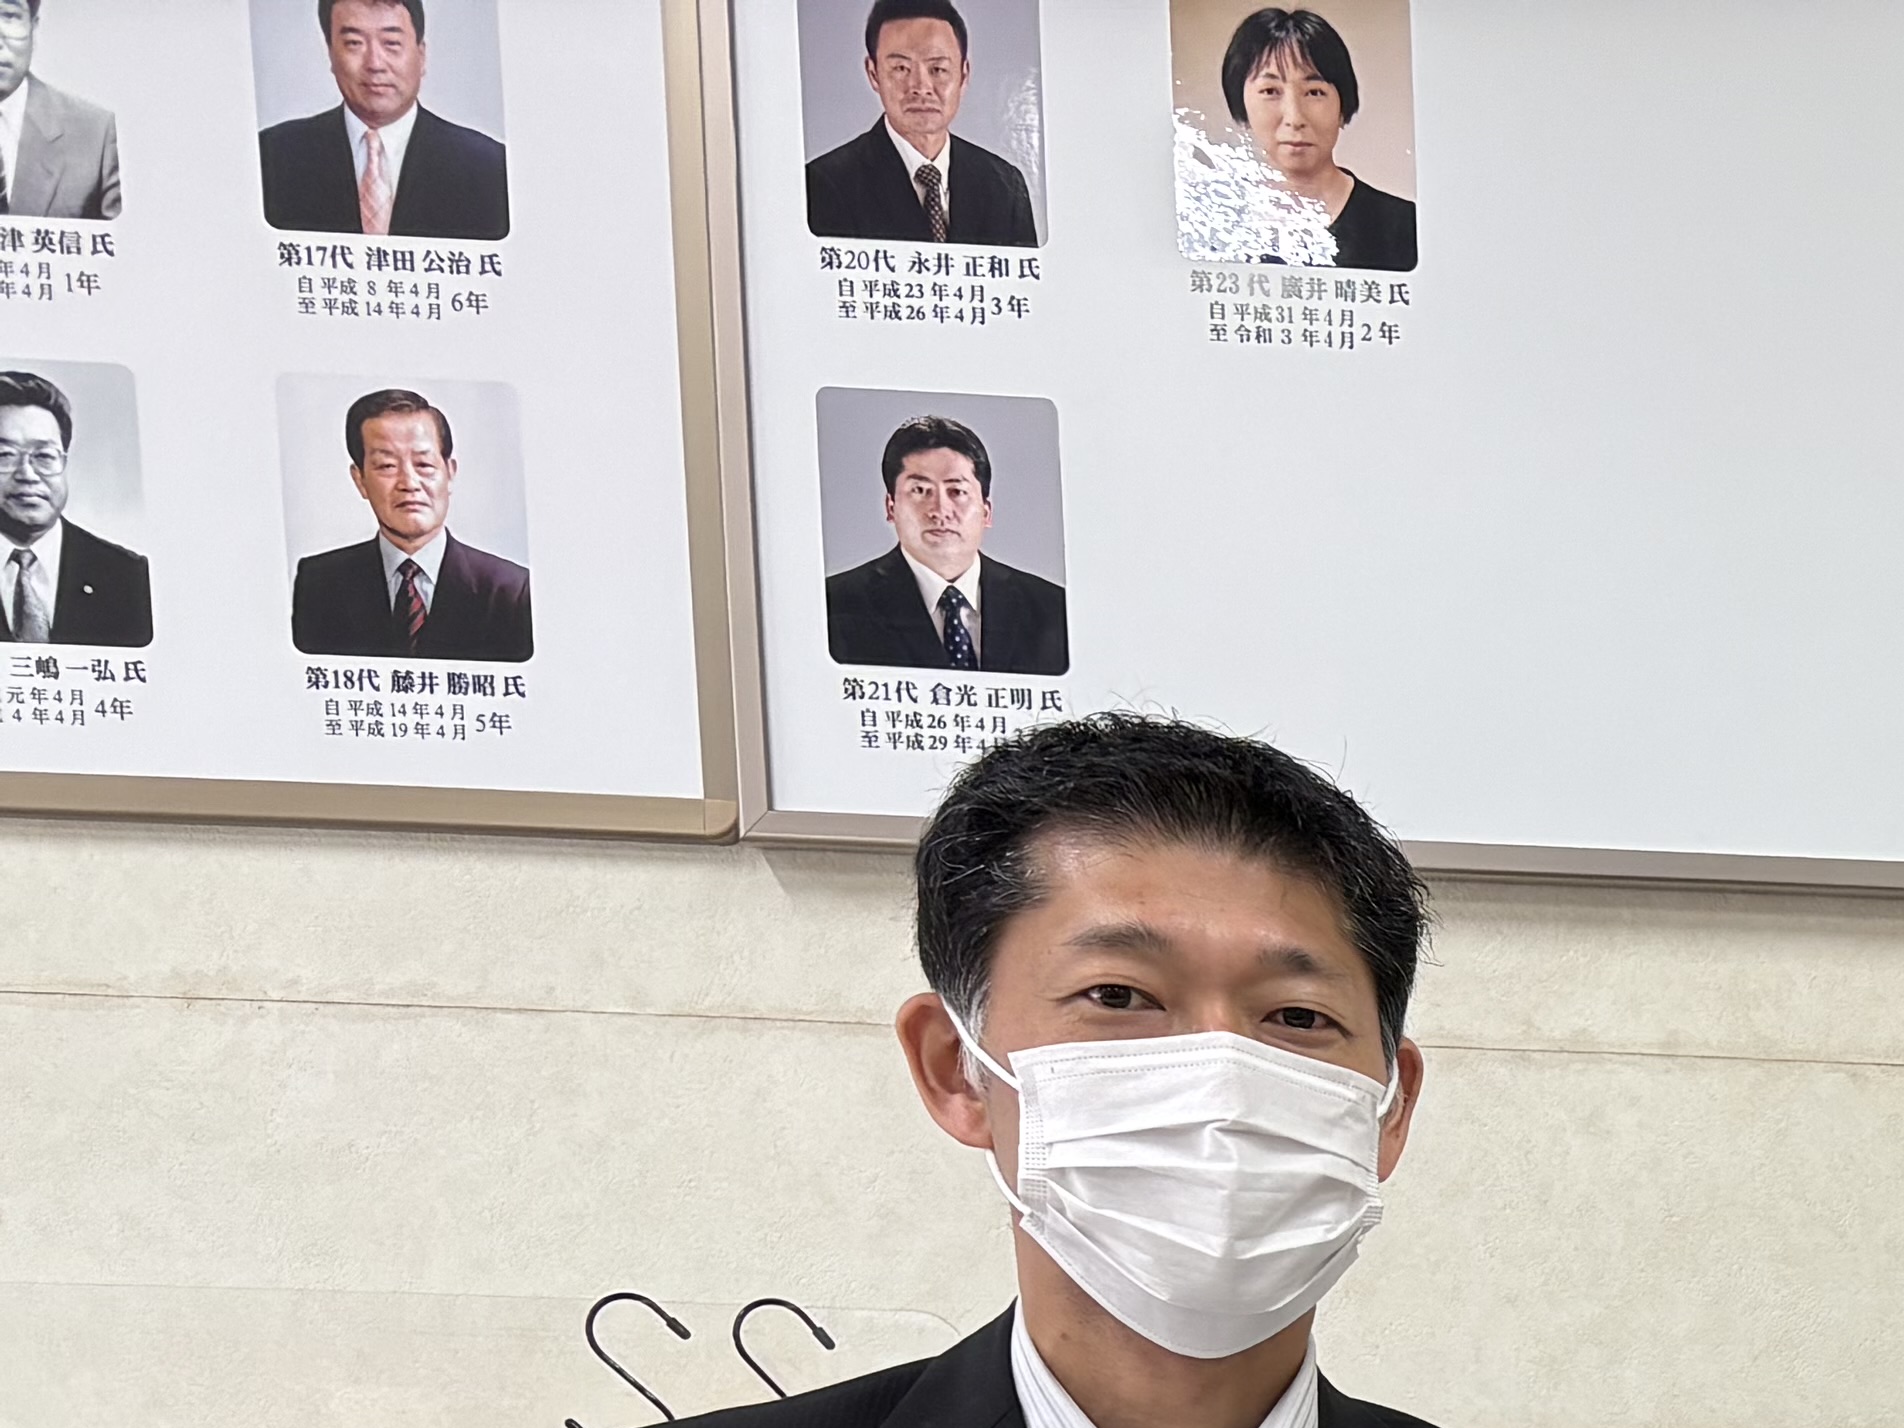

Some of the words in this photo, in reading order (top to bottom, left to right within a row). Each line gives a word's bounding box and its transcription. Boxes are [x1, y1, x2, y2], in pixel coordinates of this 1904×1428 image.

[31, 228, 82, 255] 英信
[91, 232, 115, 258] 氏
[277, 241, 354, 269] 第17代
[365, 246, 415, 272] 津田
[422, 249, 472, 275] 公治
[478, 252, 503, 277] 氏
[820, 247, 896, 273] 第20代
[907, 251, 955, 276] 永井
[962, 255, 1010, 278] 正和
[1018, 257, 1041, 281] 氏
[1389, 283, 1410, 306] 氏
[65, 659, 116, 682] 一弘
[123, 660, 147, 683] 氏
[306, 666, 380, 692] 第18代
[391, 670, 440, 694] 藤井
[447, 672, 496, 697] 勝昭
[503, 675, 526, 698] 氏
[843, 677, 918, 703] 第21代
[930, 682, 978, 707] 倉光
[986, 687, 1033, 710] 正明
[1040, 689, 1064, 712] 氏
